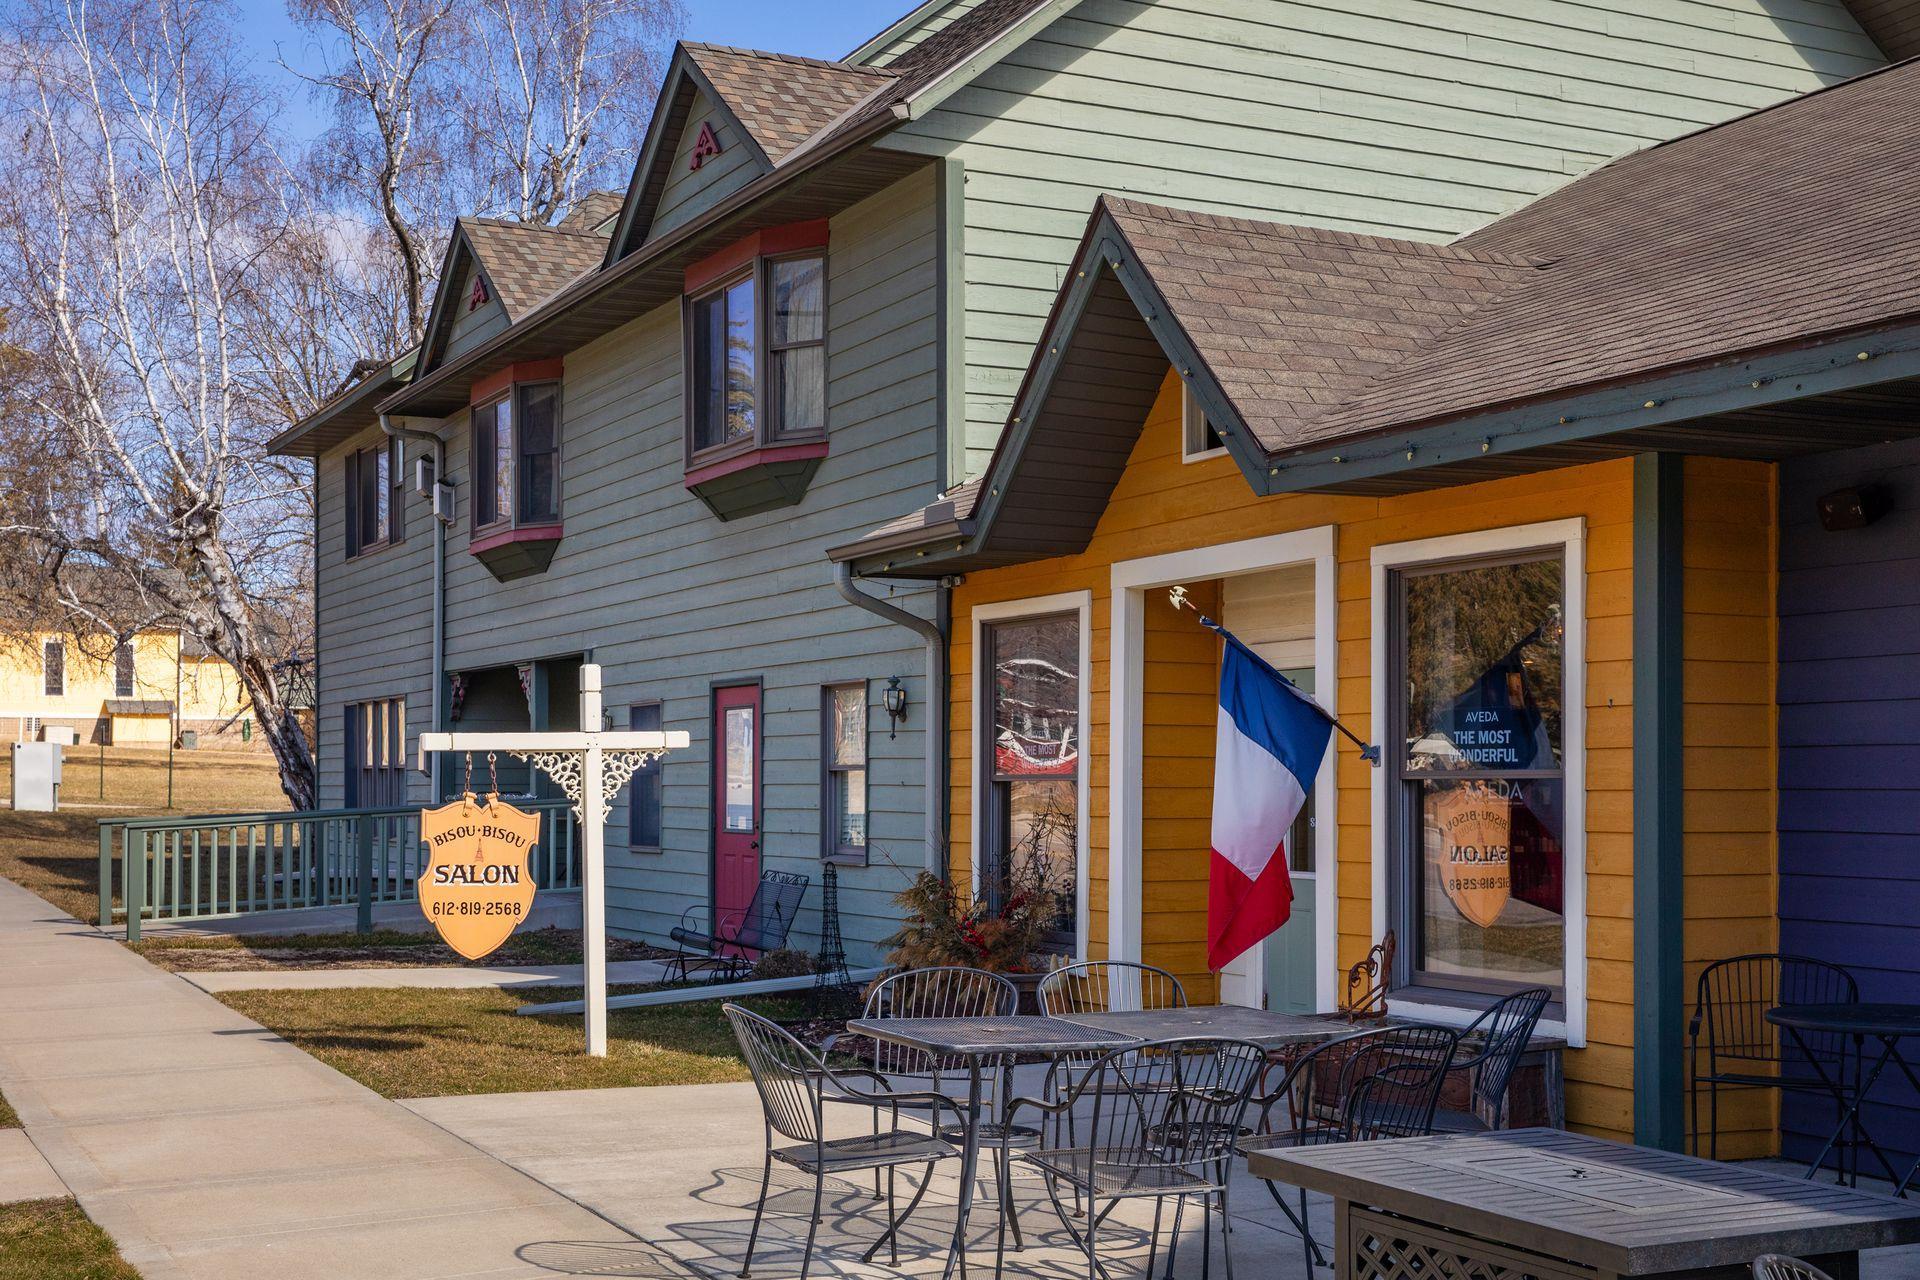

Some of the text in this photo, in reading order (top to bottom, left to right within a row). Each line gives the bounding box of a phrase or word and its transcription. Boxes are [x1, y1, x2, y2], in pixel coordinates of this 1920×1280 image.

[1465, 711, 1499, 722] AVEDA
[1454, 730, 1511, 744] THE MOST
[1024, 744, 1057, 755] THE MOST
[433, 864, 520, 885] SALON
